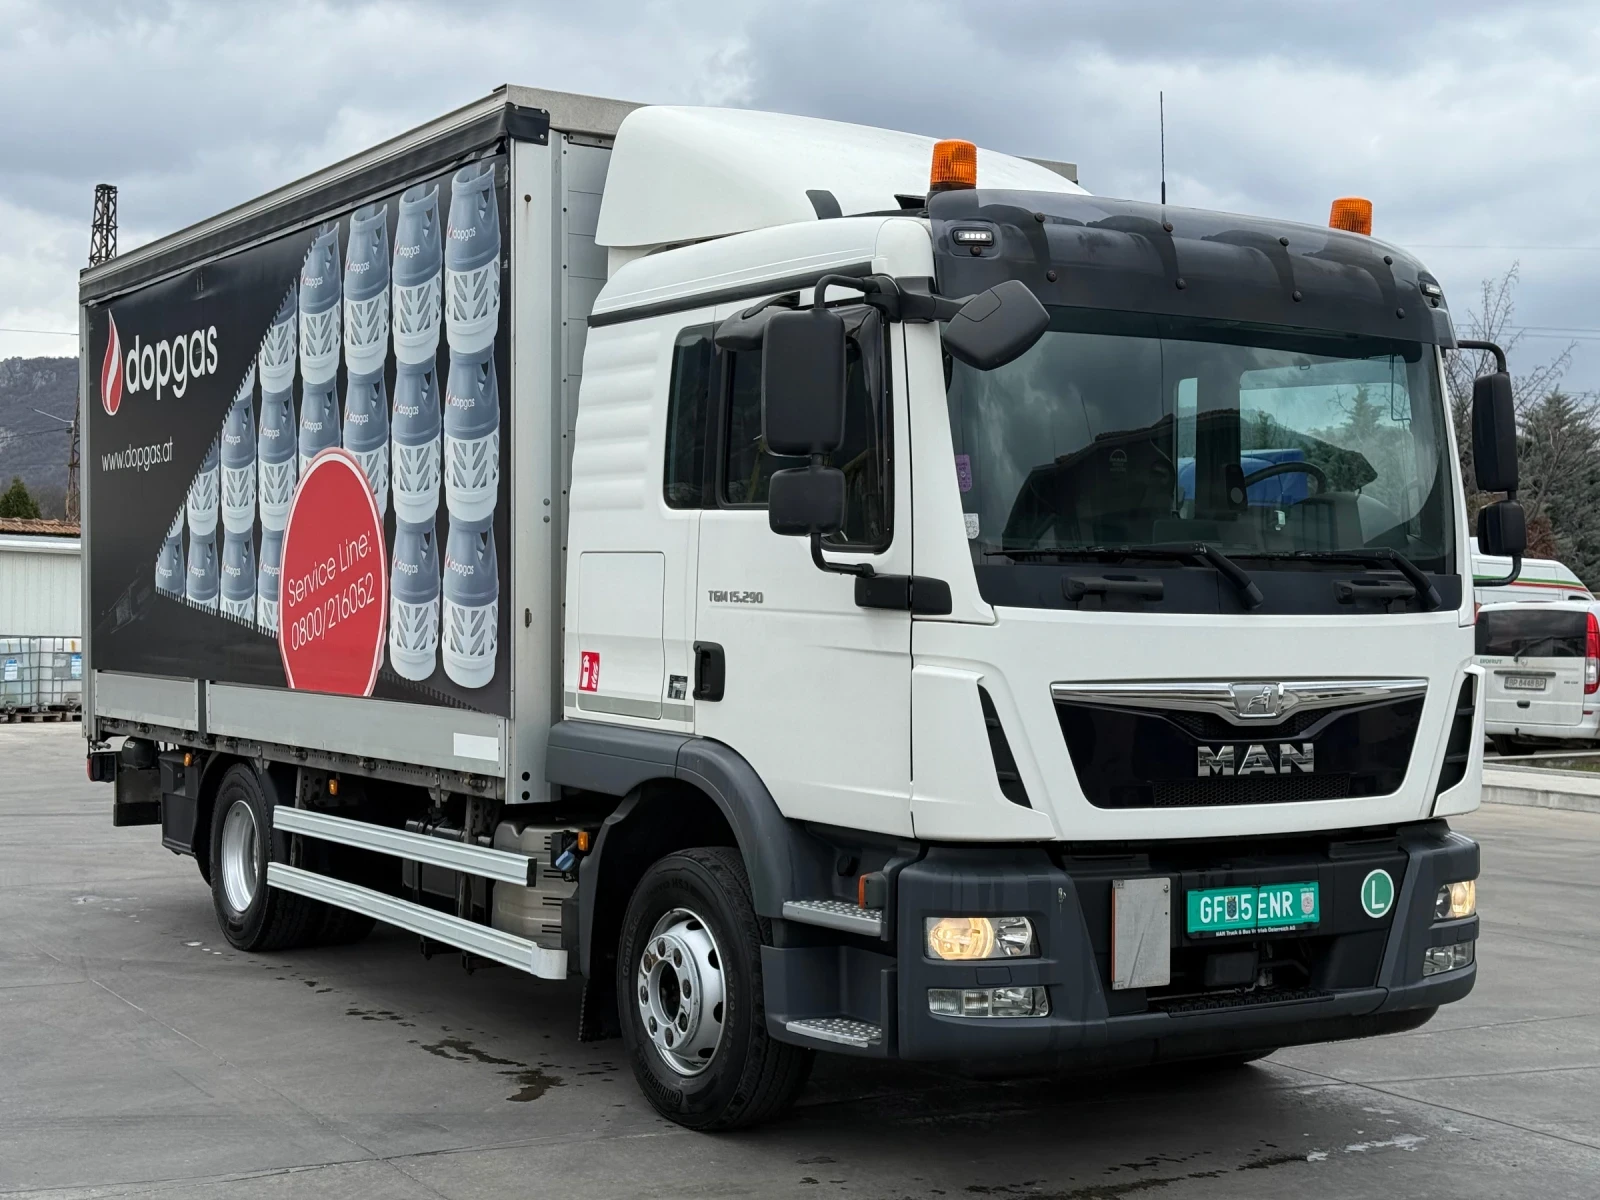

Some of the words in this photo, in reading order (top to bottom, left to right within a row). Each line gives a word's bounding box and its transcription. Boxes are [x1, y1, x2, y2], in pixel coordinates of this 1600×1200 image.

[454, 226, 475, 241] dopgas
[400, 244, 420, 258] dopgas
[351, 261, 370, 274] dopgas
[305, 274, 323, 288] dopgas
[126, 326, 218, 400] dopgas
[399, 404, 419, 417] dopgas
[452, 397, 475, 410] dopgas
[350, 412, 368, 424] dopgas
[263, 427, 280, 438] dopgas
[304, 420, 322, 432] dopgas
[225, 433, 240, 444] dopgas
[102, 436, 173, 472] www.dopgas.at
[191, 566, 205, 577] dopgas
[226, 566, 240, 577] dopgas
[288, 557, 336, 608] Service
[338, 531, 372, 572] Line:
[398, 560, 418, 575] dopgas
[452, 559, 474, 576] dopgas
[708, 590, 728, 602] TGM
[729, 590, 764, 604] 15.290
[291, 572, 374, 650] 0800/216052
[1198, 743, 1314, 776] MAN
[1372, 880, 1384, 909] L
[1200, 896, 1224, 923] GF
[1257, 891, 1293, 919] ENR
